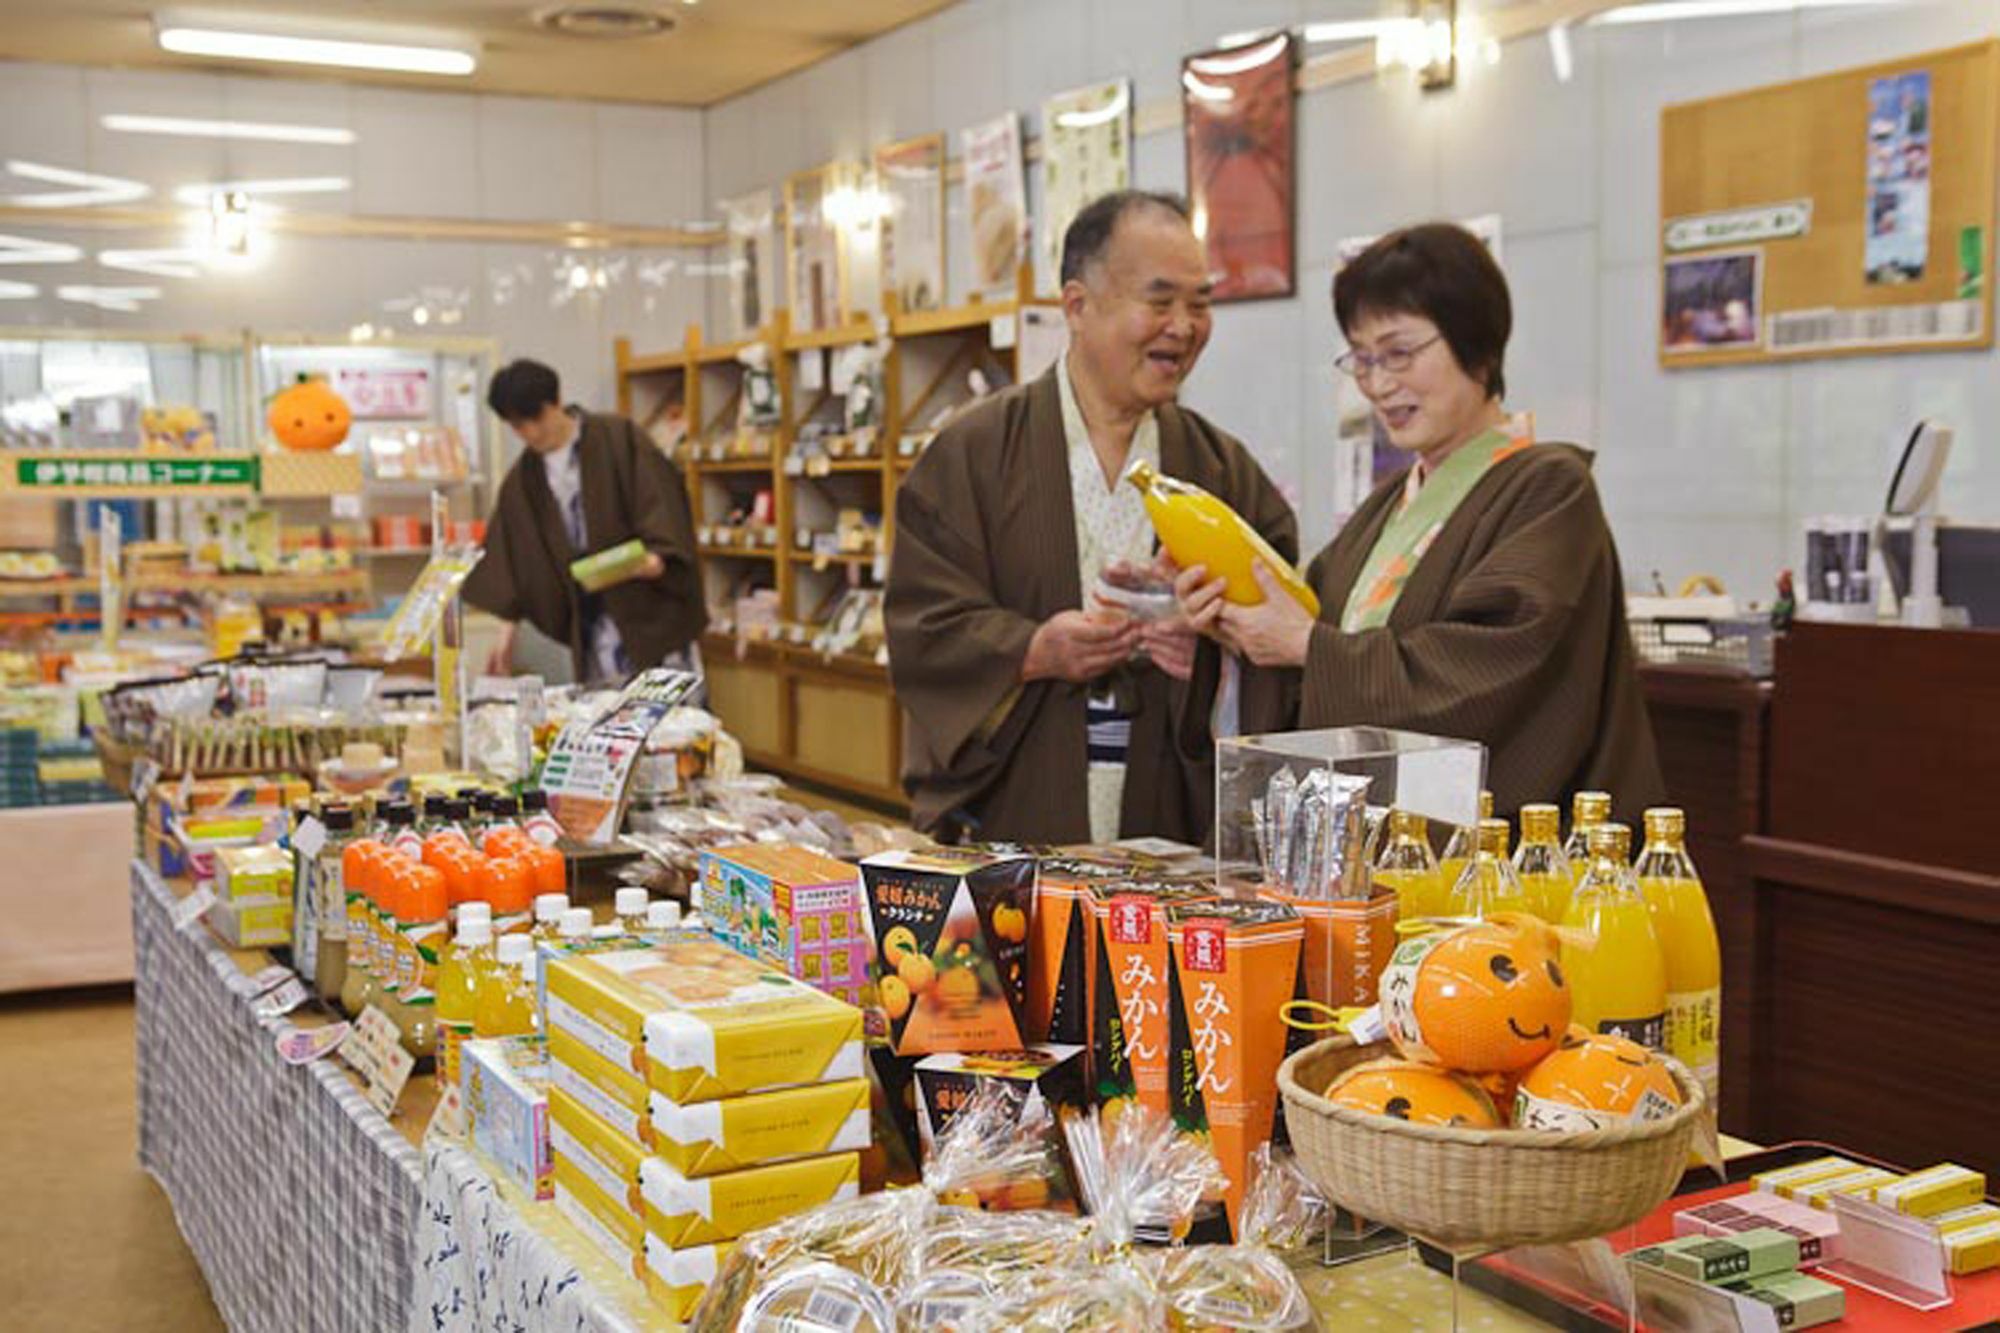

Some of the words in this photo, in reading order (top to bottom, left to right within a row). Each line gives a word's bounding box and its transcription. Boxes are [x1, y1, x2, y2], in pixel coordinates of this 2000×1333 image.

[875, 883, 942, 911] 愛媛みかん
[1121, 953, 1159, 1060] みかん
[1354, 924, 1372, 1003] MIKA
[1194, 980, 1233, 1095] みかん
